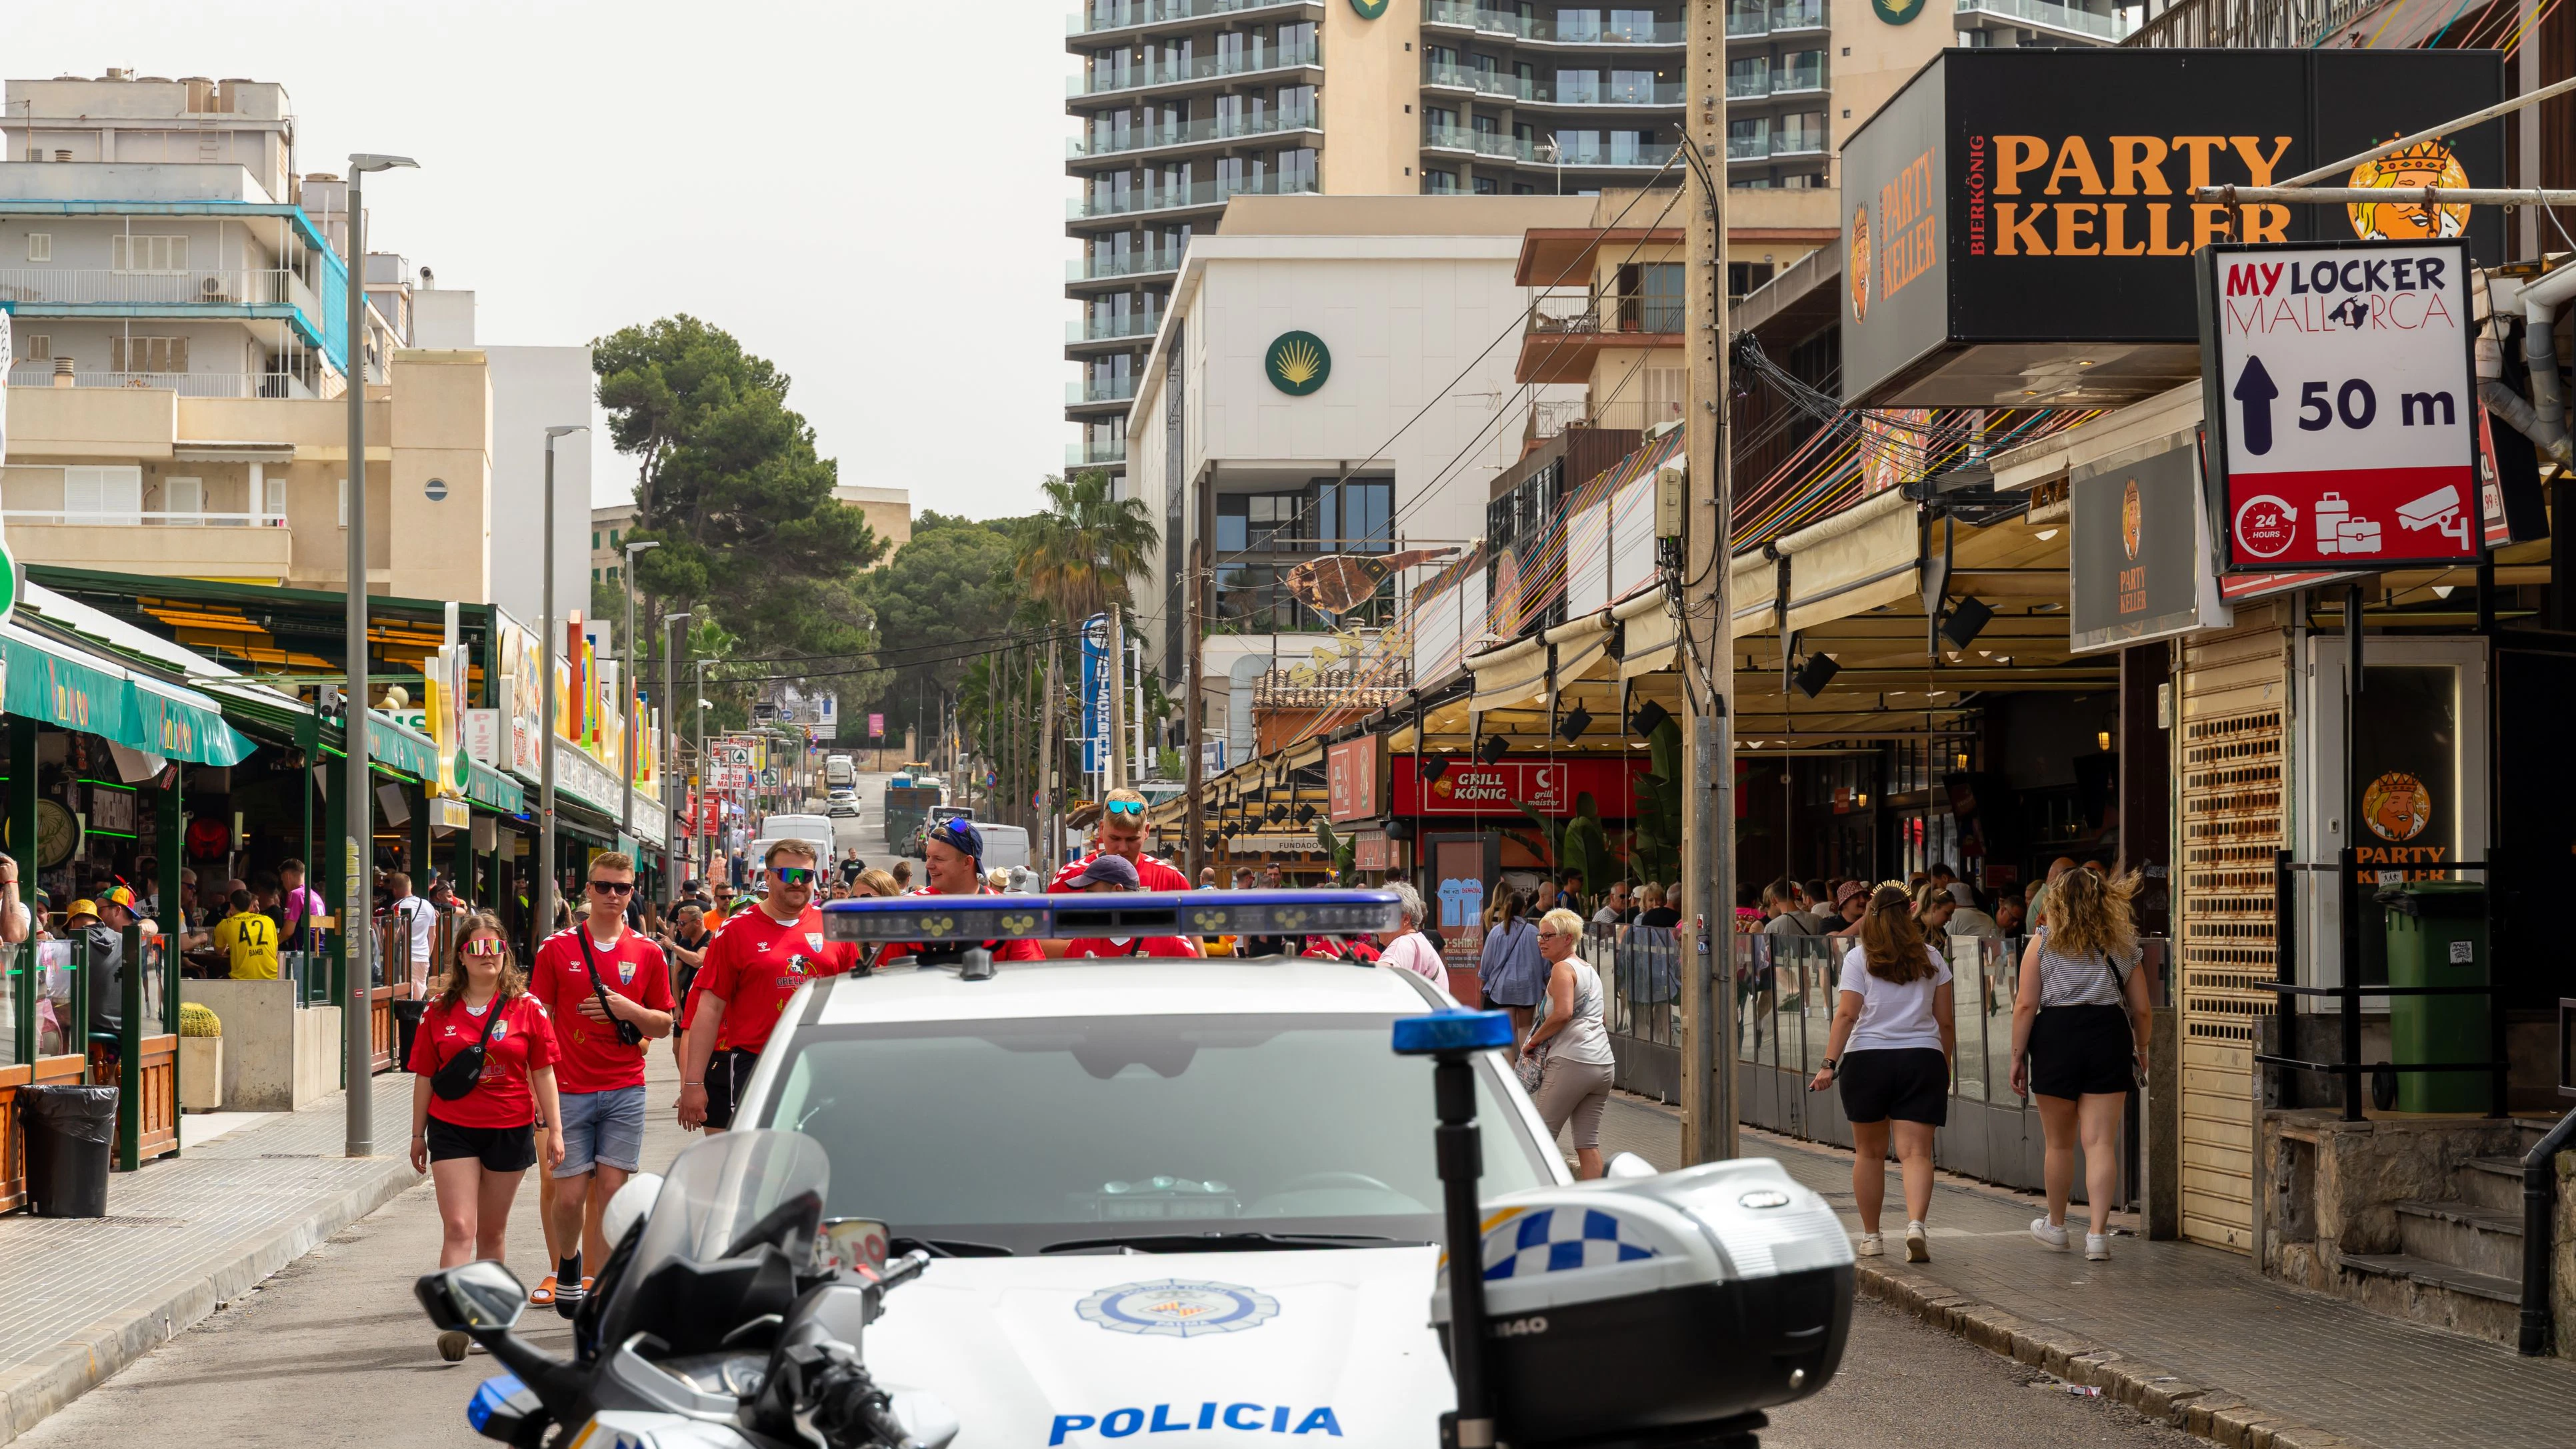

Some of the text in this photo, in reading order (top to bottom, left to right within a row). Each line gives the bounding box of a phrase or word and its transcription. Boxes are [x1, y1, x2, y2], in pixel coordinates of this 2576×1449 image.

[1992, 135, 2293, 195] PARTY
[1882, 146, 1935, 244] PARTY
[1969, 135, 1985, 256] BIERKÖNIG
[1993, 203, 2291, 256] KELLER
[1883, 214, 1937, 300] KELLER
[2226, 257, 2446, 297] MY LOCKER
[2298, 377, 2455, 431] 50 m
[2485, 494, 2493, 512] ,99
[2255, 513, 2277, 528] 24
[2252, 530, 2281, 539] HOURS
[2120, 565, 2146, 593] PARTY
[2119, 590, 2147, 614] KELLER
[474, 713, 491, 759] PIZZ
[717, 780, 746, 788] MAKET
[1457, 773, 1504, 786] GRILL
[1454, 785, 1507, 800] KÖNIG
[1534, 790, 1553, 800] grill
[2355, 847, 2446, 864] PARTY
[2357, 870, 2446, 884] KLER
[238, 920, 269, 947] 42
[1443, 938, 1479, 948] T-SHIRT
[248, 948, 263, 957] BAMBI
[1048, 1402, 1344, 1448] POLICIA
